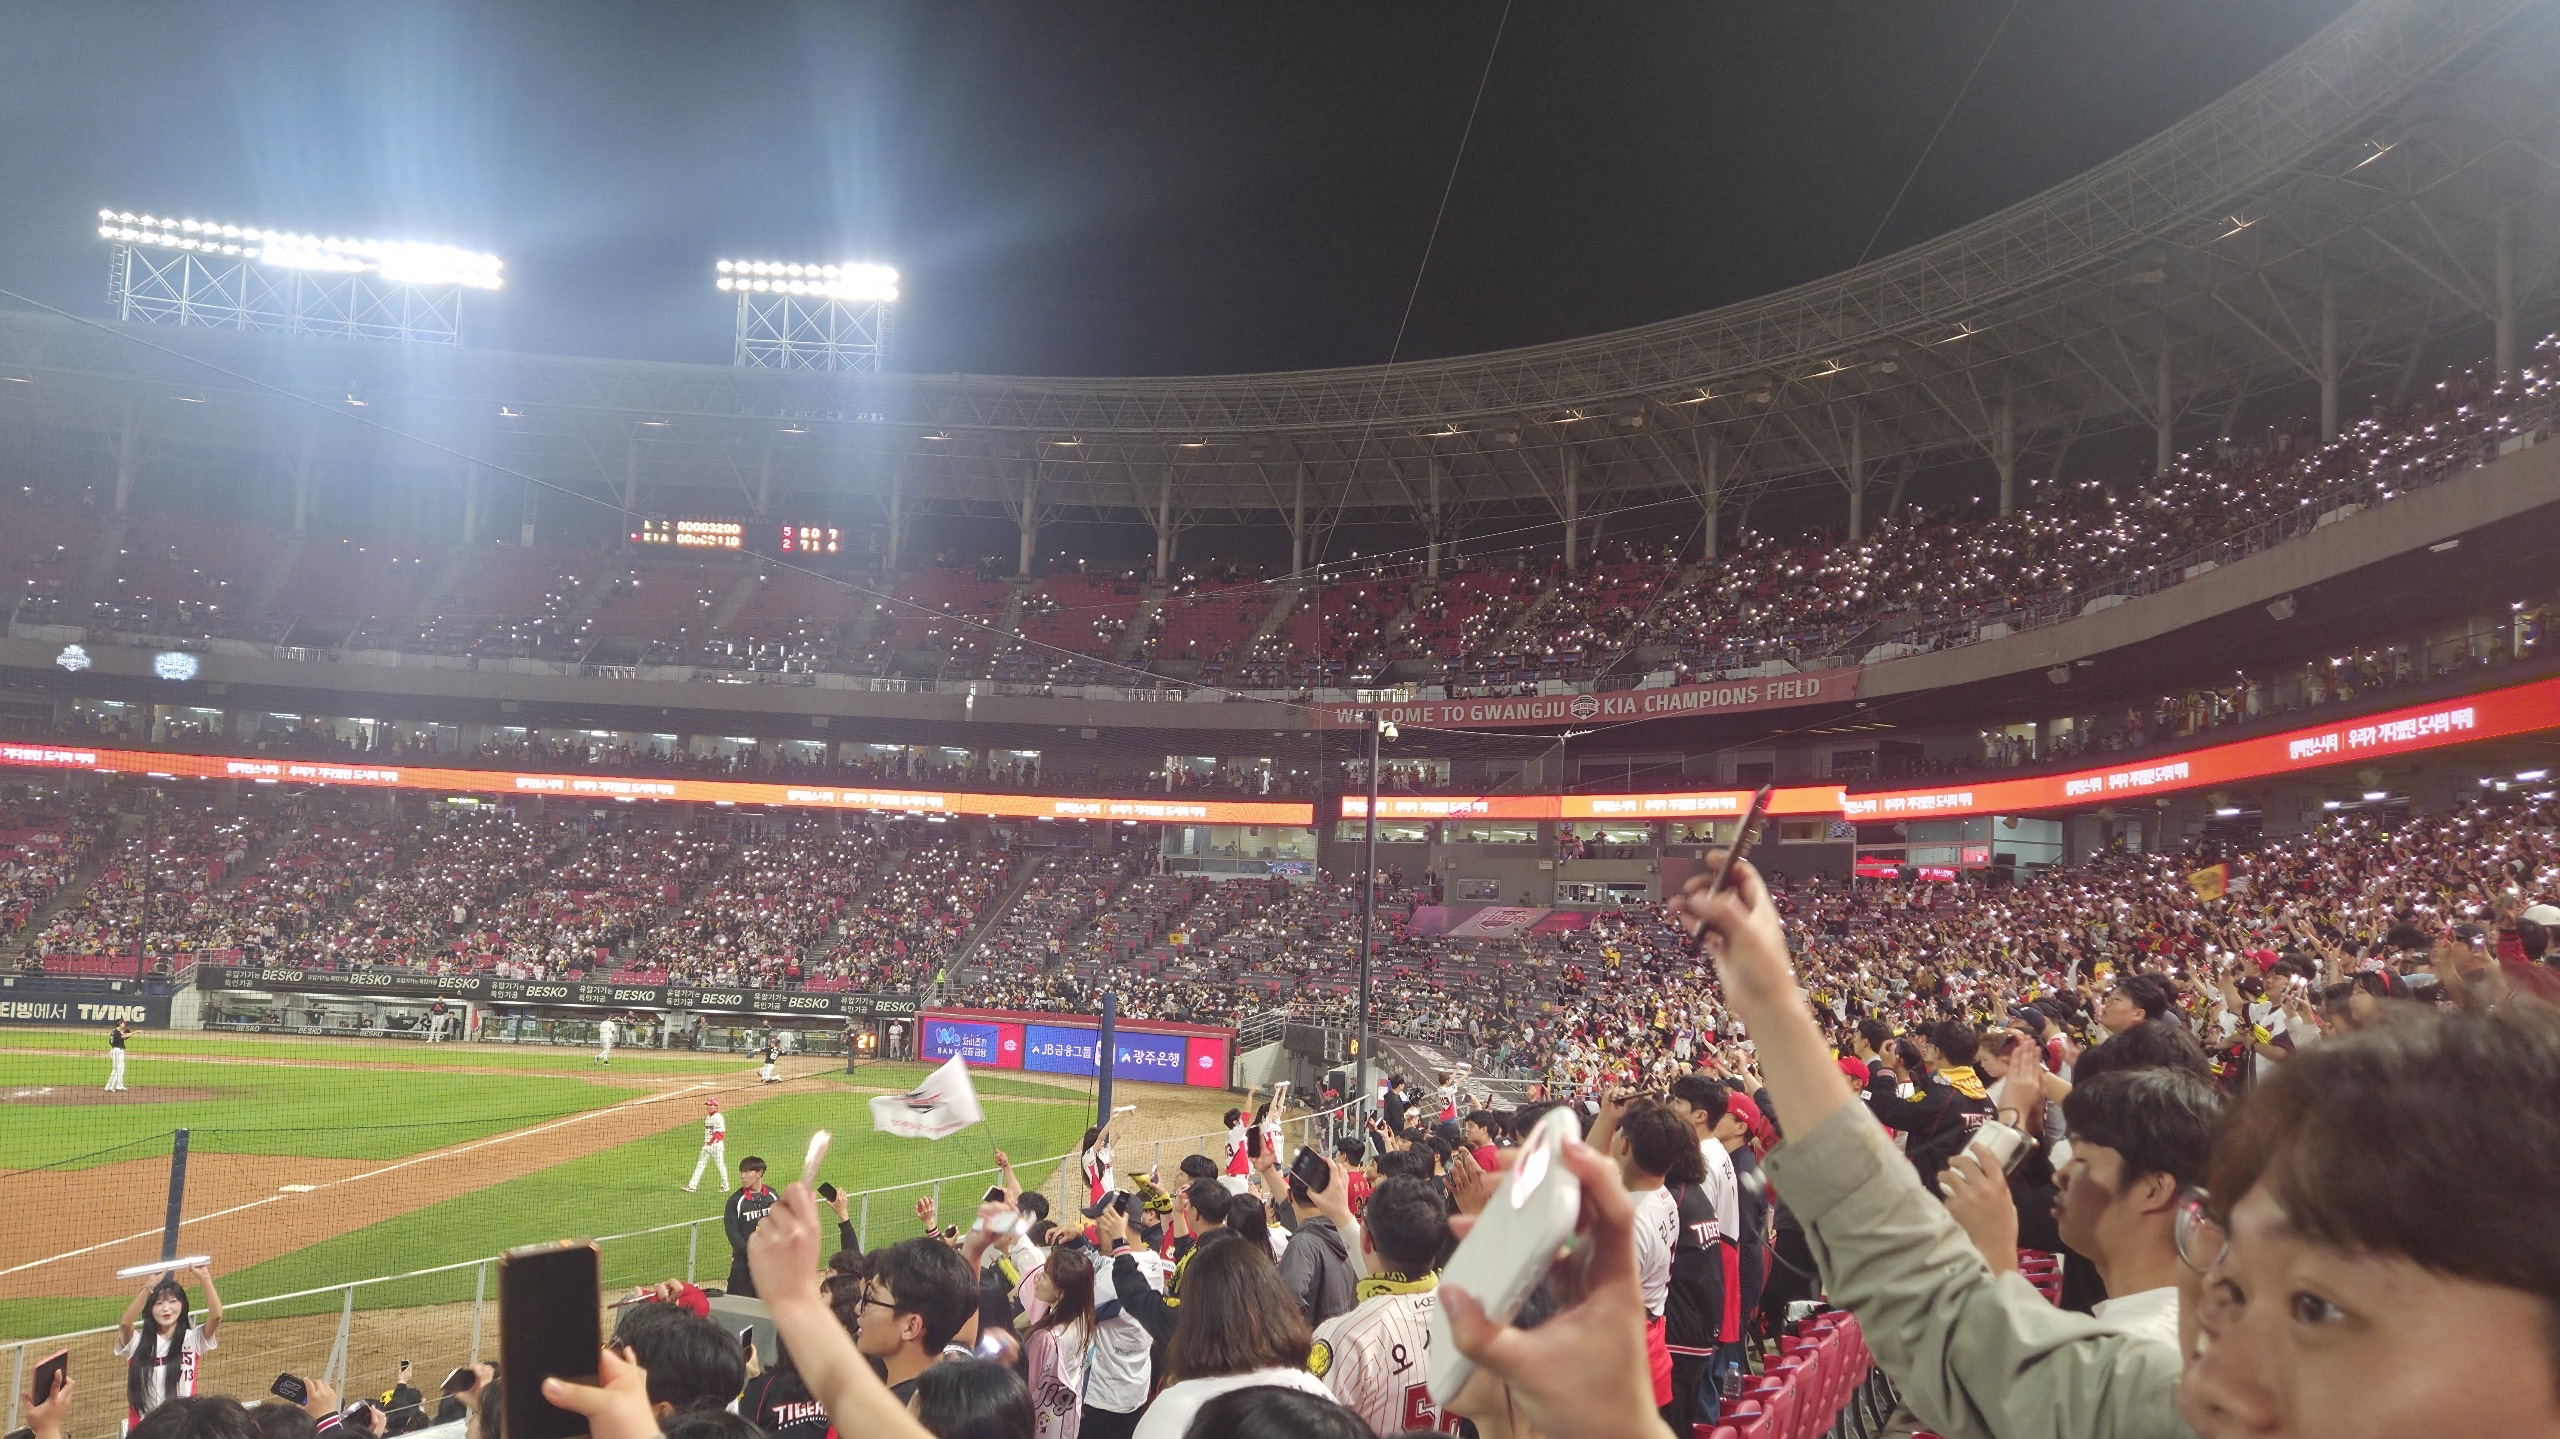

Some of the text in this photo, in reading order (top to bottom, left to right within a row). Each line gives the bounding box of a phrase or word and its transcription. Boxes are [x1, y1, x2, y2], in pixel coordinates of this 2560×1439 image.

[783, 526, 792, 537] 5
[828, 529, 838, 539] 7
[643, 533, 669, 541] KIA
[782, 539, 791, 549] 2
[827, 541, 838, 552] 4
[1337, 706, 1434, 724] WECOME
[1441, 706, 1465, 722] TO
[1471, 701, 1565, 720] GWANGJU
[1604, 697, 1636, 714] KIA
[1645, 685, 1757, 712] CHAMPIONS
[1767, 678, 1819, 701] FIELD
[2348, 726, 2377, 748] 우리가
[2418, 712, 2449, 734] 도시의
[262, 969, 303, 981] BESKO
[350, 974, 392, 986] BESKO
[438, 977, 479, 989] BESKO
[526, 985, 568, 997] BESKO
[614, 989, 655, 1001] BESKO
[701, 993, 742, 1005] BESKO
[788, 997, 829, 1009] BESKO
[0, 1002, 145, 1022] 티빙에서 TVING
[875, 1000, 915, 1013] BESKO
[857, 1034, 875, 1048] 21
[1041, 1043, 1092, 1059] JB금융그룹
[1133, 1049, 1180, 1068] 광주은행
[1034, 1375, 1076, 1417] Tig
[772, 1400, 827, 1425] TIGER
